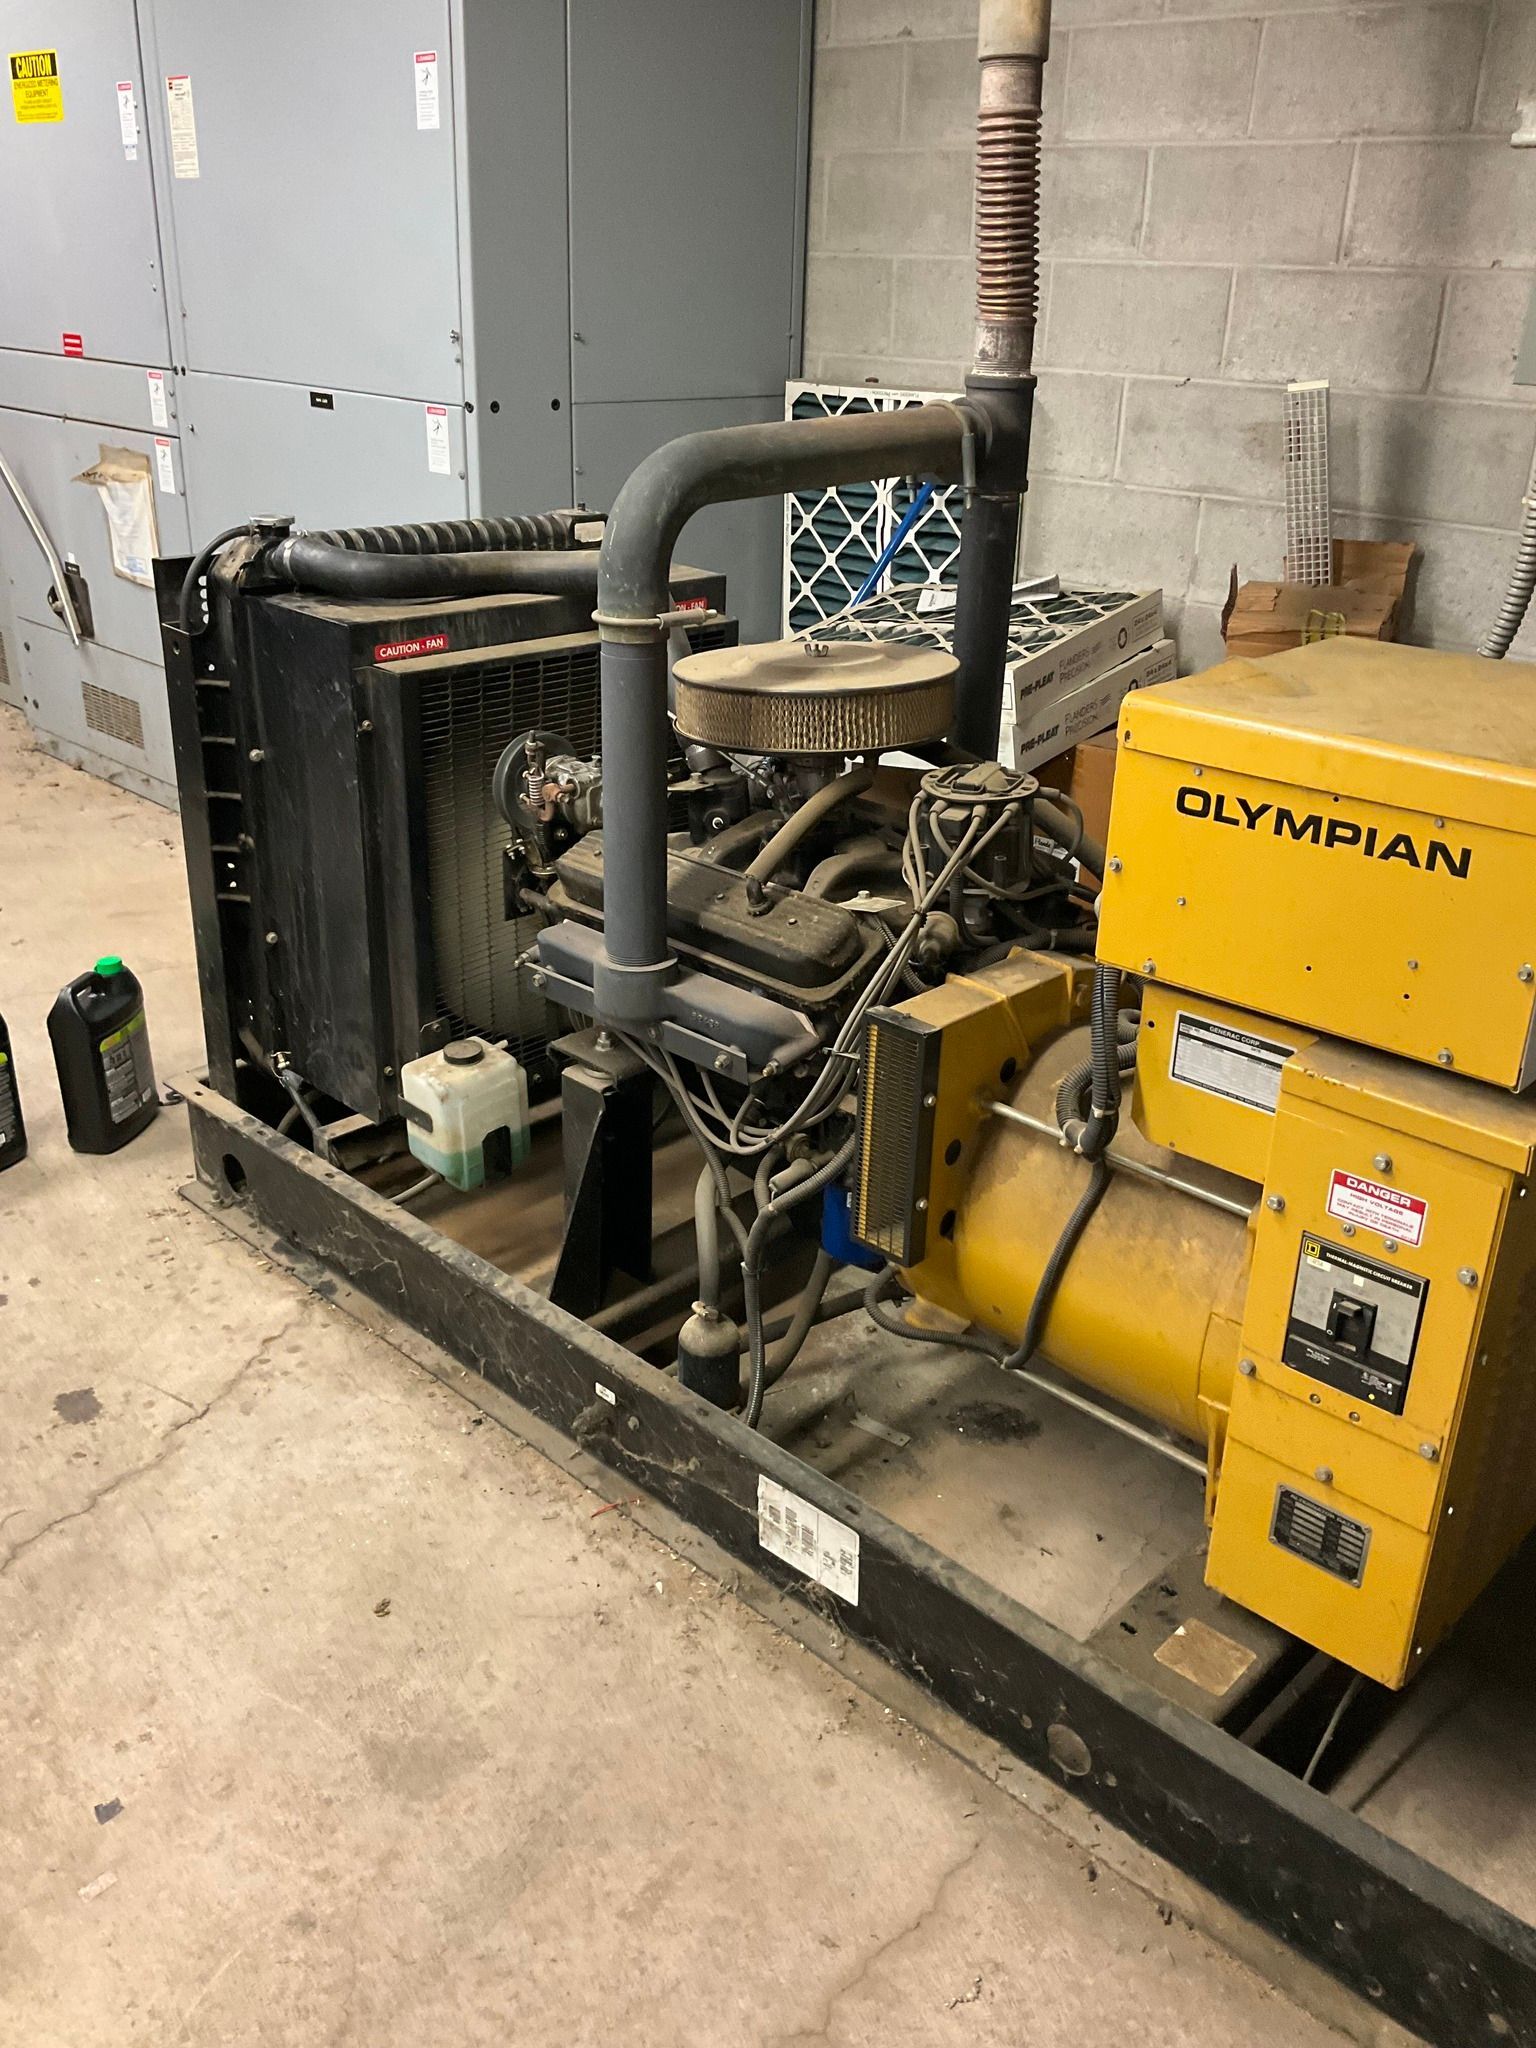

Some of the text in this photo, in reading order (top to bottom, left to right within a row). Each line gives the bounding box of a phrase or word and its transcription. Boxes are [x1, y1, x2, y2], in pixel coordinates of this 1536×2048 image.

[16, 54, 52, 78] CAUTION
[380, 642, 420, 658] CAUTION
[426, 638, 444, 649] FAN
[1059, 649, 1090, 671] FLANDERS
[1020, 671, 1055, 700] PRE-PLEAT
[1065, 701, 1098, 723] FLANDERS
[1021, 724, 1060, 755] PRE-PLEAT
[1177, 786, 1472, 879] OLYMPIAN
[1209, 1026, 1241, 1041] GENERAC
[1346, 1177, 1411, 1208] DANGER
[1350, 1193, 1404, 1216] HIGH VOLTAGE
[1326, 1252, 1373, 1275] THERMAL-MAGNETIC
[1373, 1270, 1391, 1281] CIRCUIT
[1391, 1277, 1413, 1290] BREAKER
